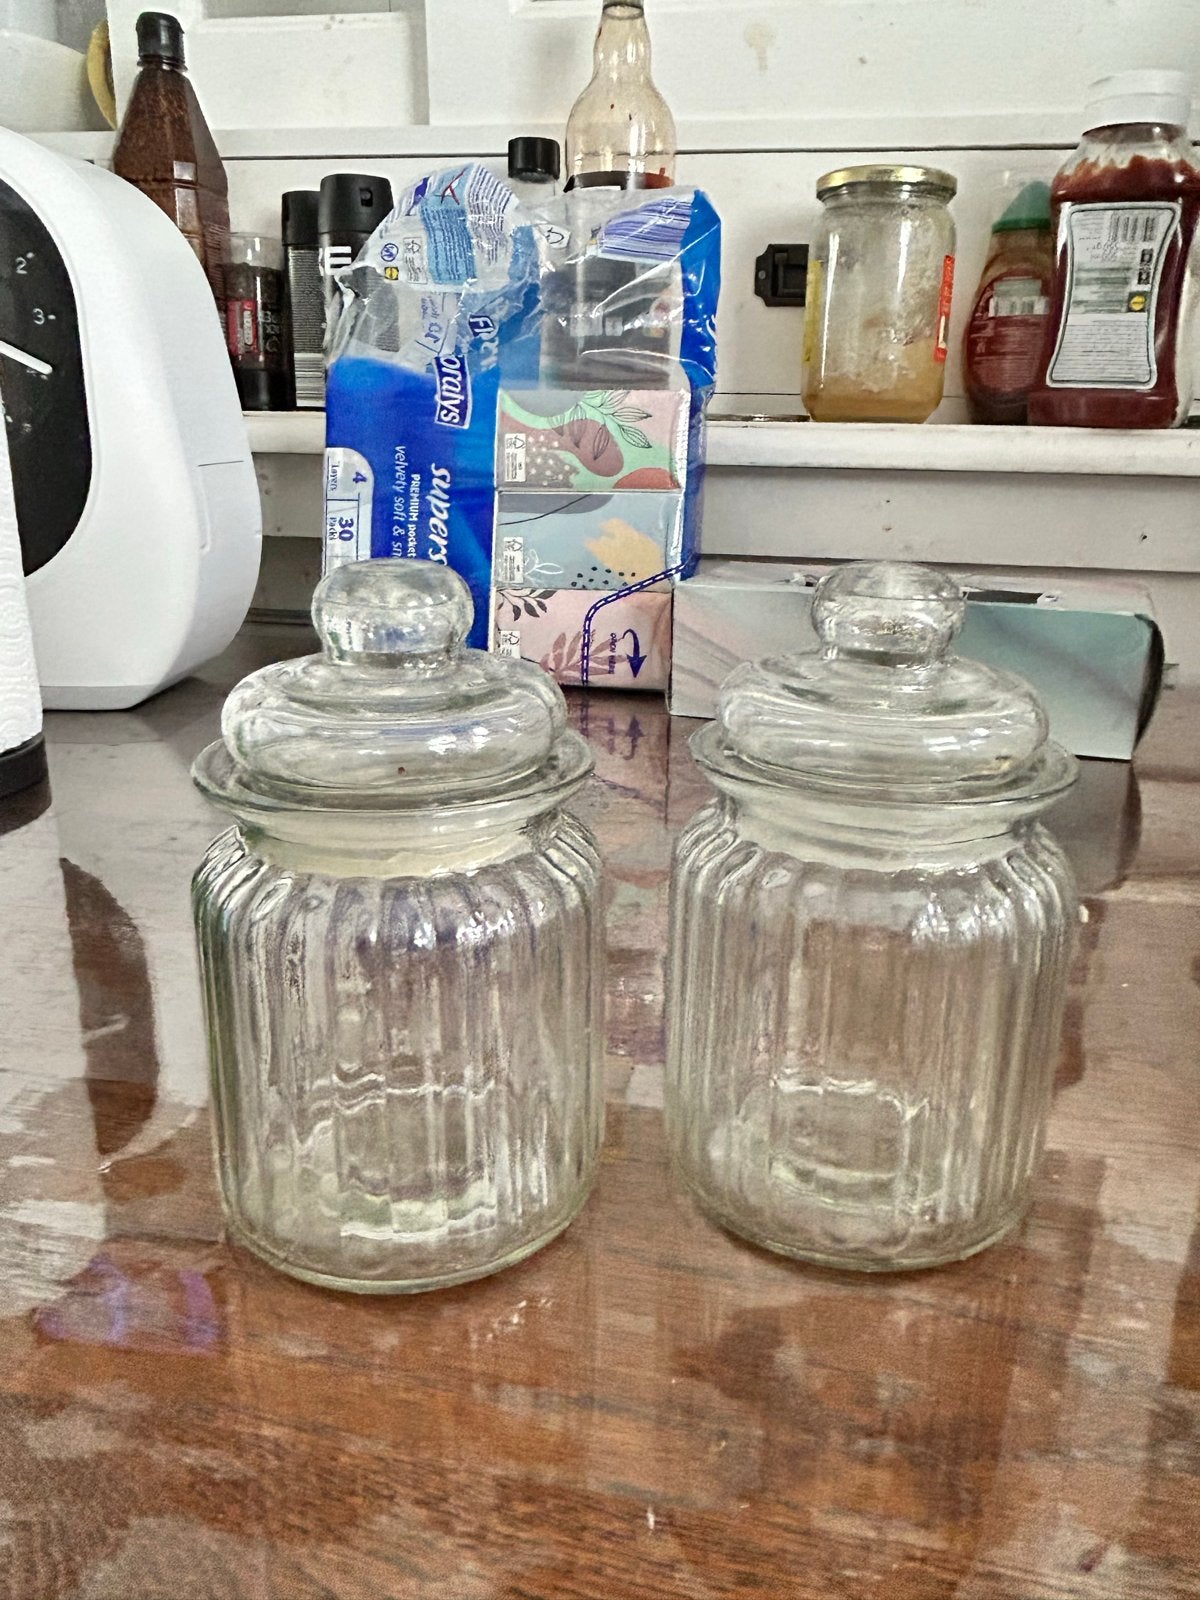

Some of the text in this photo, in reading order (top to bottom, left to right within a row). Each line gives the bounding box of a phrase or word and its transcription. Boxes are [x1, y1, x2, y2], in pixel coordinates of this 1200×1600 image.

[15, 257, 27, 274] 2
[319, 246, 353, 276] E
[33, 308, 45, 325] 3
[352, 471, 367, 484] 4
[392, 445, 408, 559] velvety soft & sn
[407, 473, 421, 558] PREMIUM pocket
[338, 517, 354, 542] 30
